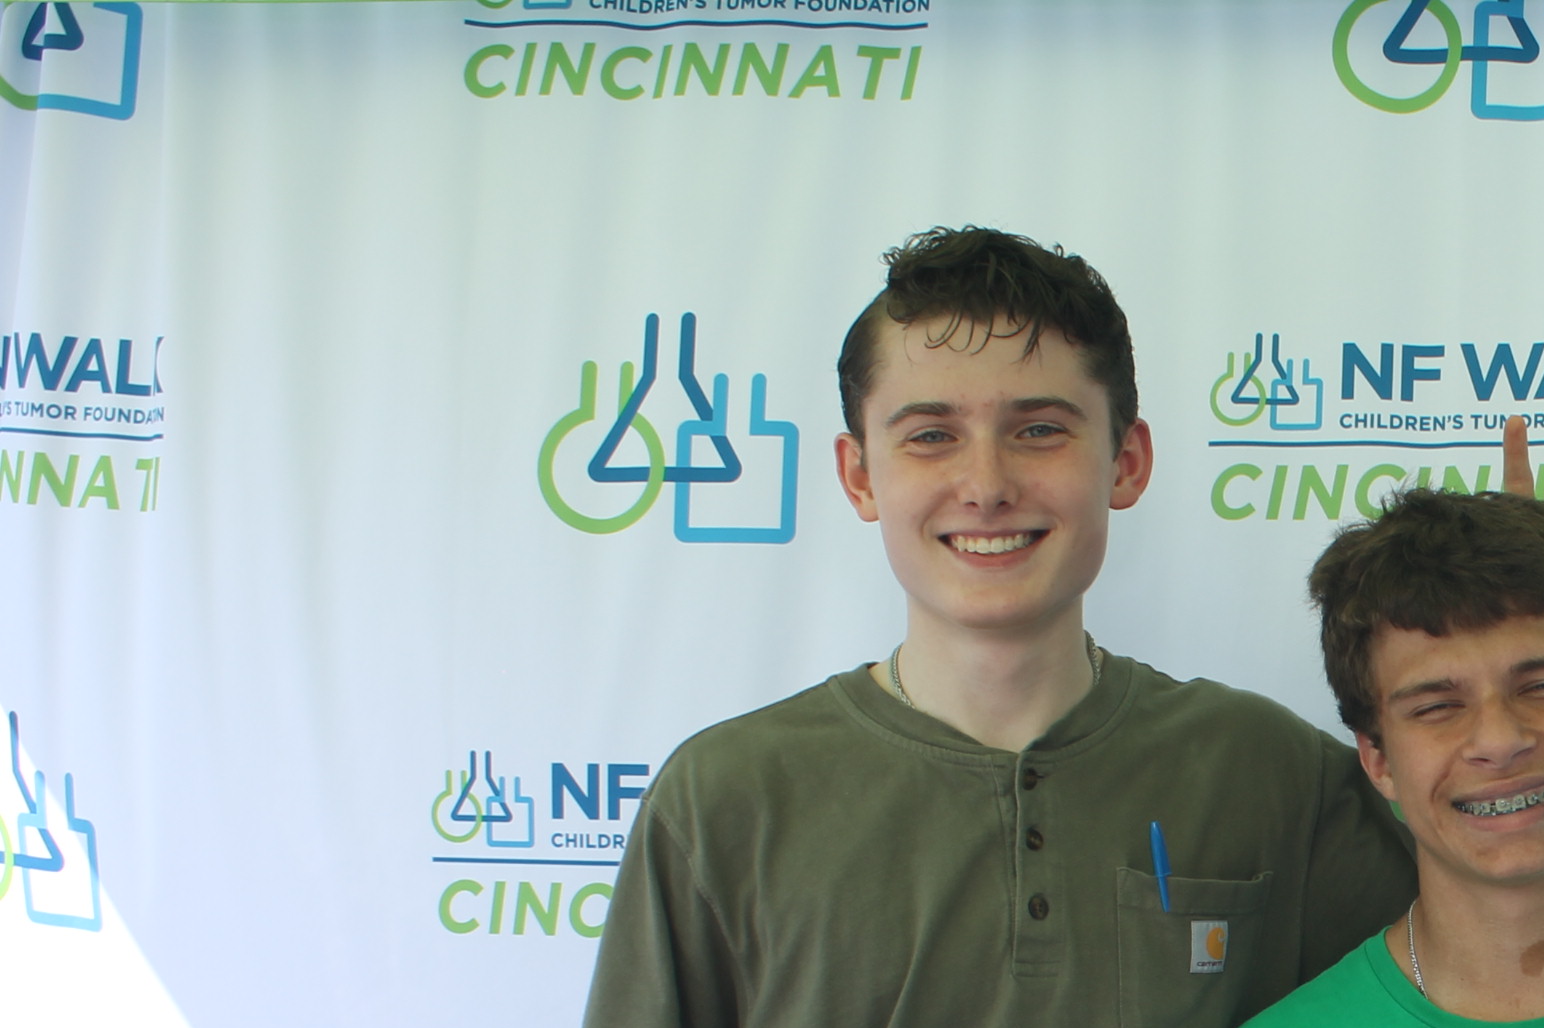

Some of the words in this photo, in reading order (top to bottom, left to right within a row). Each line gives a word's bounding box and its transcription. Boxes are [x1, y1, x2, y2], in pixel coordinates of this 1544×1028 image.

[464, 42, 923, 100] CINCINNATI
[1341, 342, 1445, 402] NF
[15, 401, 77, 420] TUMOR
[1339, 413, 1464, 432] CHILDREN'S
[551, 762, 650, 821] NF
